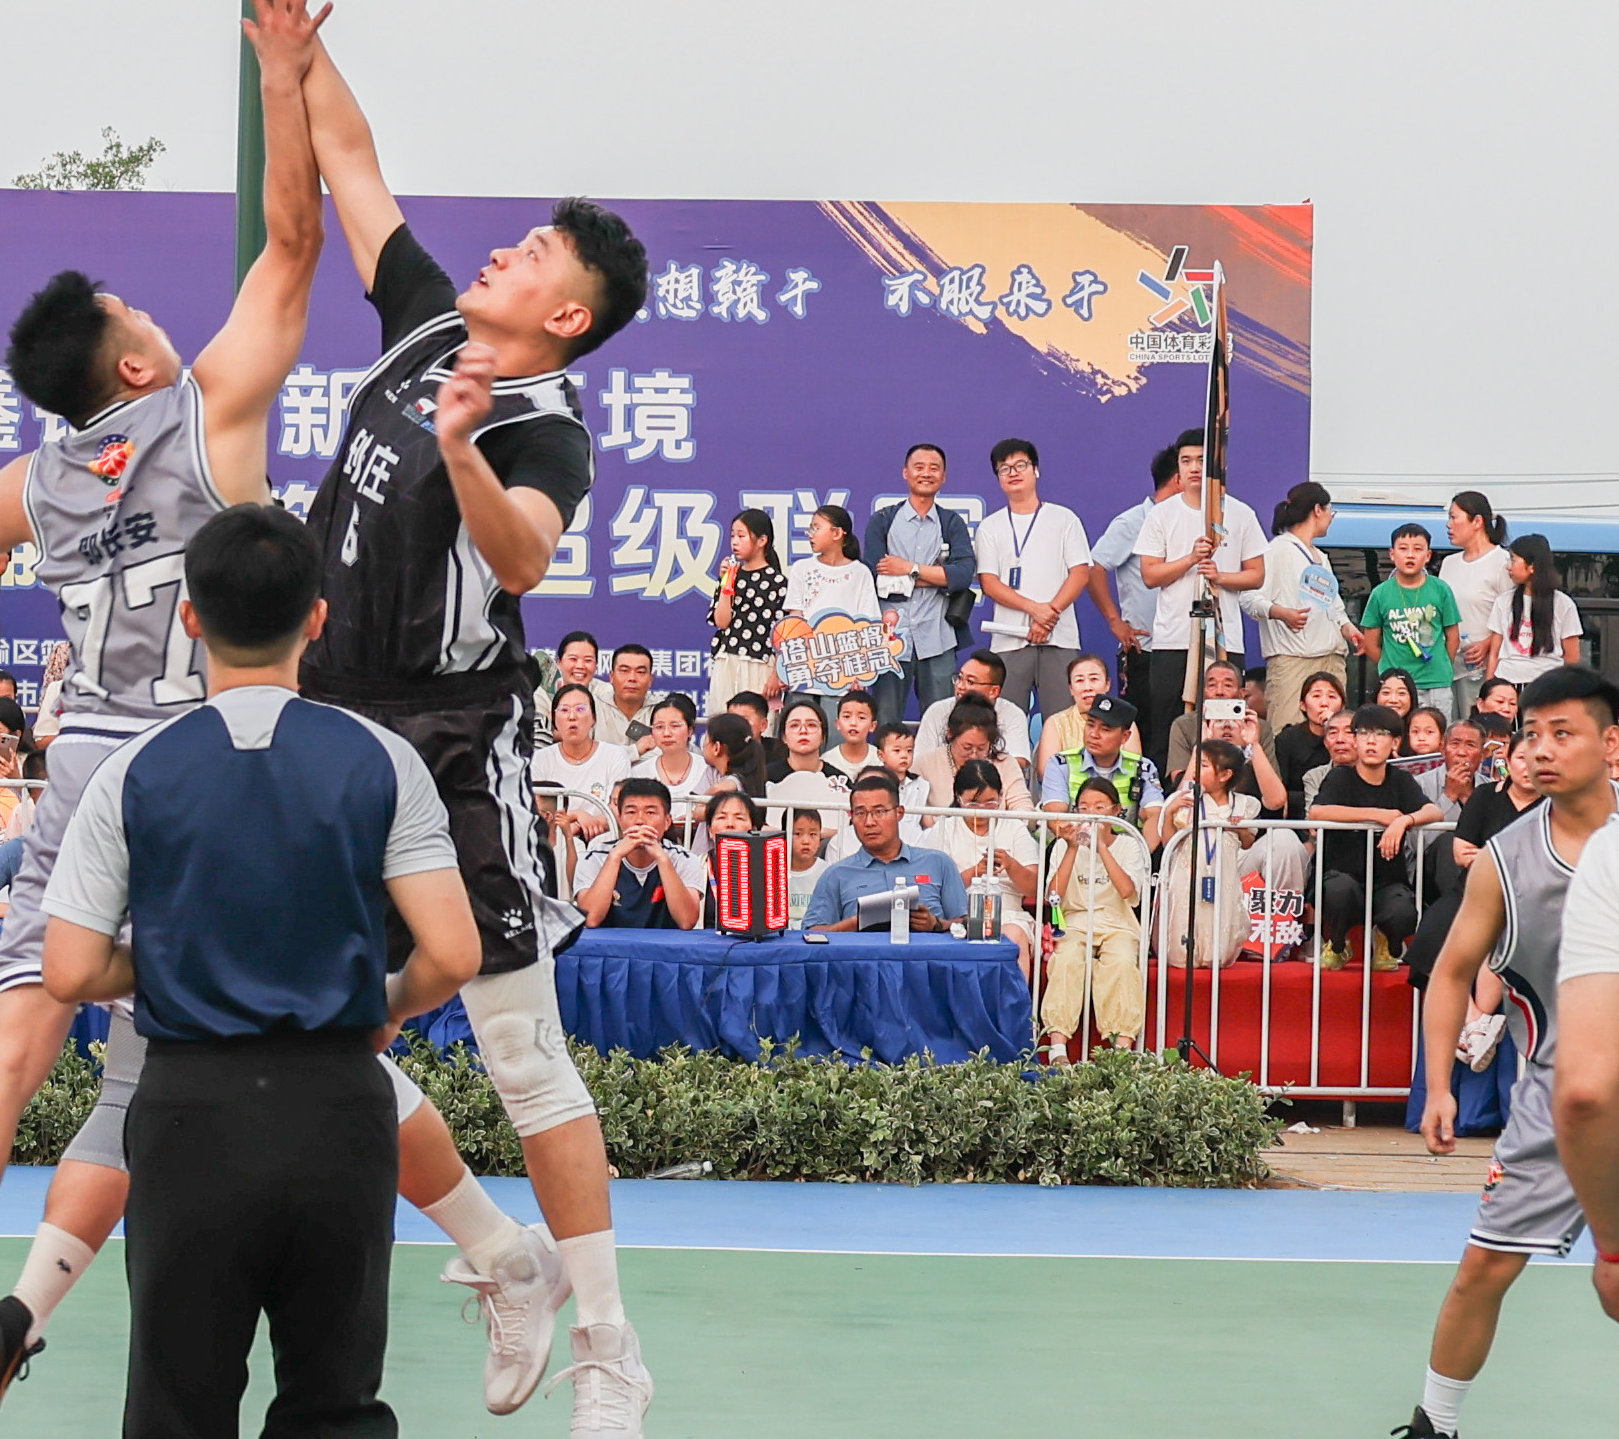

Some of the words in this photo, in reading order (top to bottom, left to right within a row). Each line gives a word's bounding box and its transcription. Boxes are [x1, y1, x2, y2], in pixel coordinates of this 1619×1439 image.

[636, 260, 819, 321] 想赣干
[1130, 333, 1233, 351] 中国体育彩
[1130, 353, 1156, 361] CHINA
[1158, 353, 1191, 361] SPORTS
[60, 549, 207, 706] 77
[780, 625, 883, 665] 塔山篮将
[1390, 621, 1420, 633] WITH
[786, 647, 893, 691] 勇夺桂冠
